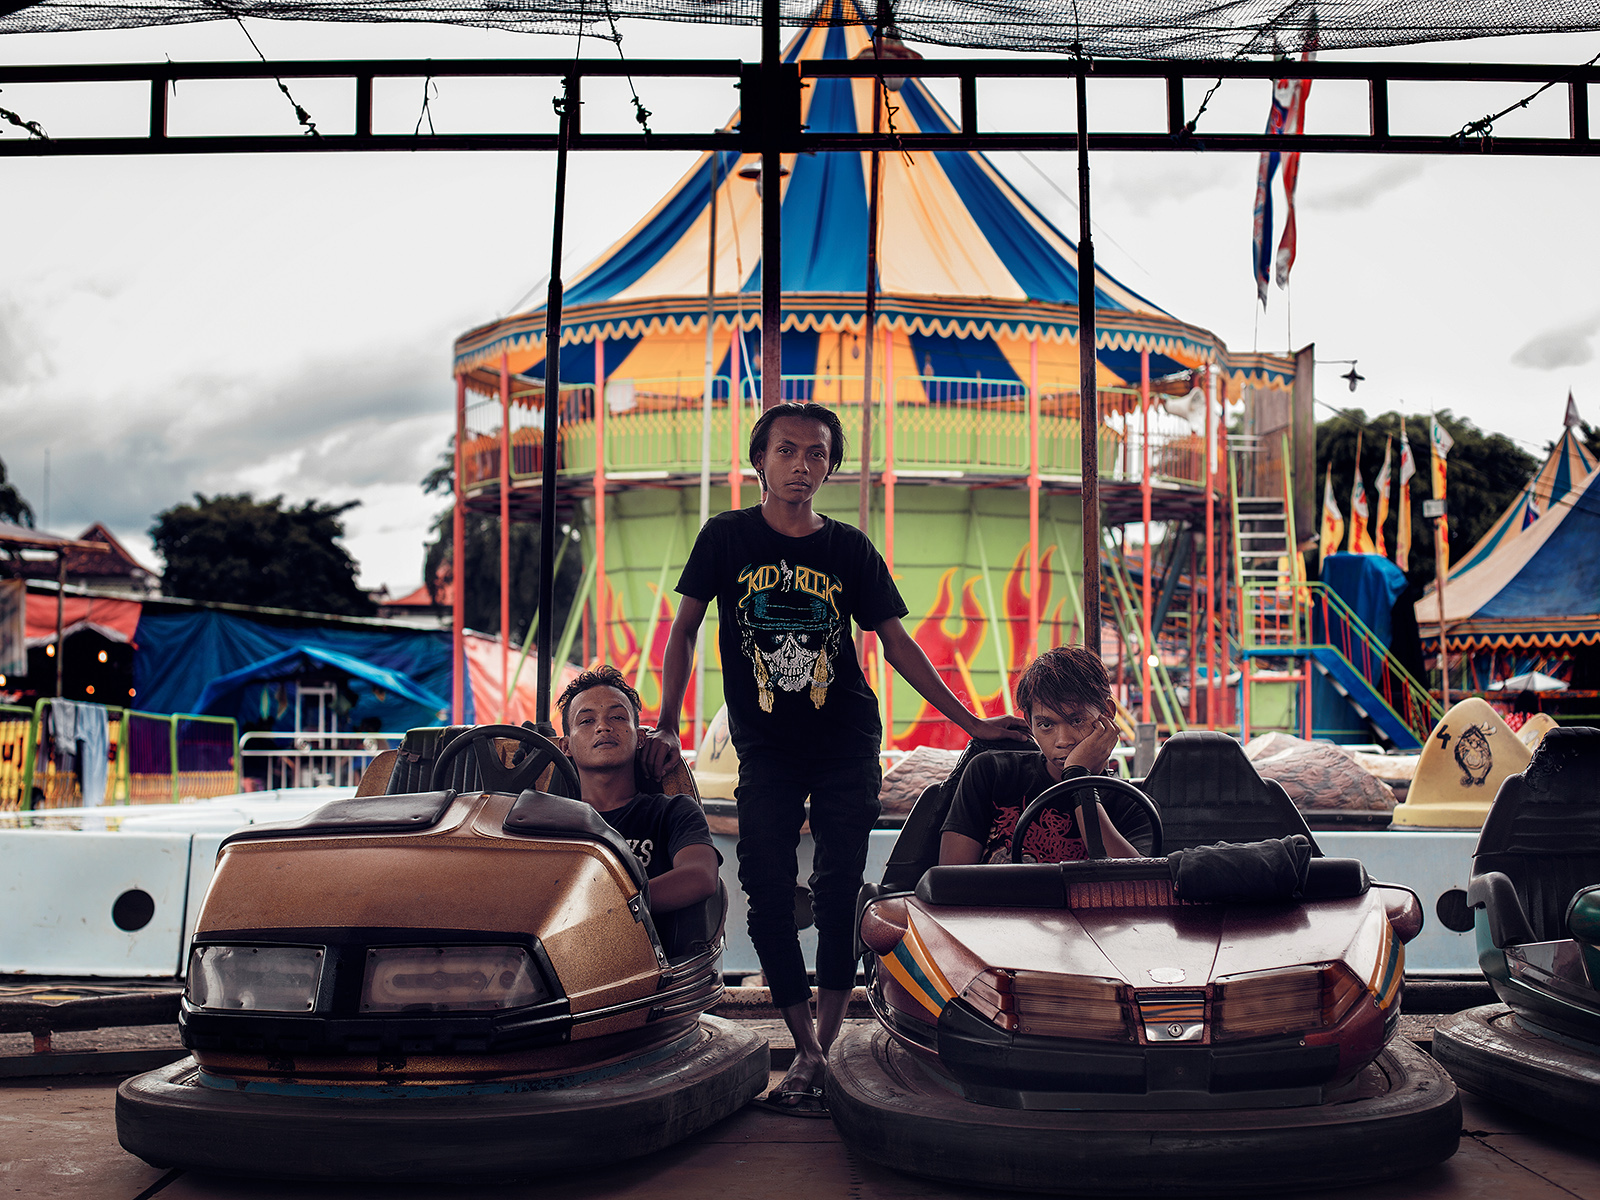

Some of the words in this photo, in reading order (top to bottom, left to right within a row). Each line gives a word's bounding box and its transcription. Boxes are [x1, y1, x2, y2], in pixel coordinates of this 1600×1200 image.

[737, 564, 780, 609] KID
[794, 565, 843, 620] ROCK
[1436, 724, 1452, 750] 4
